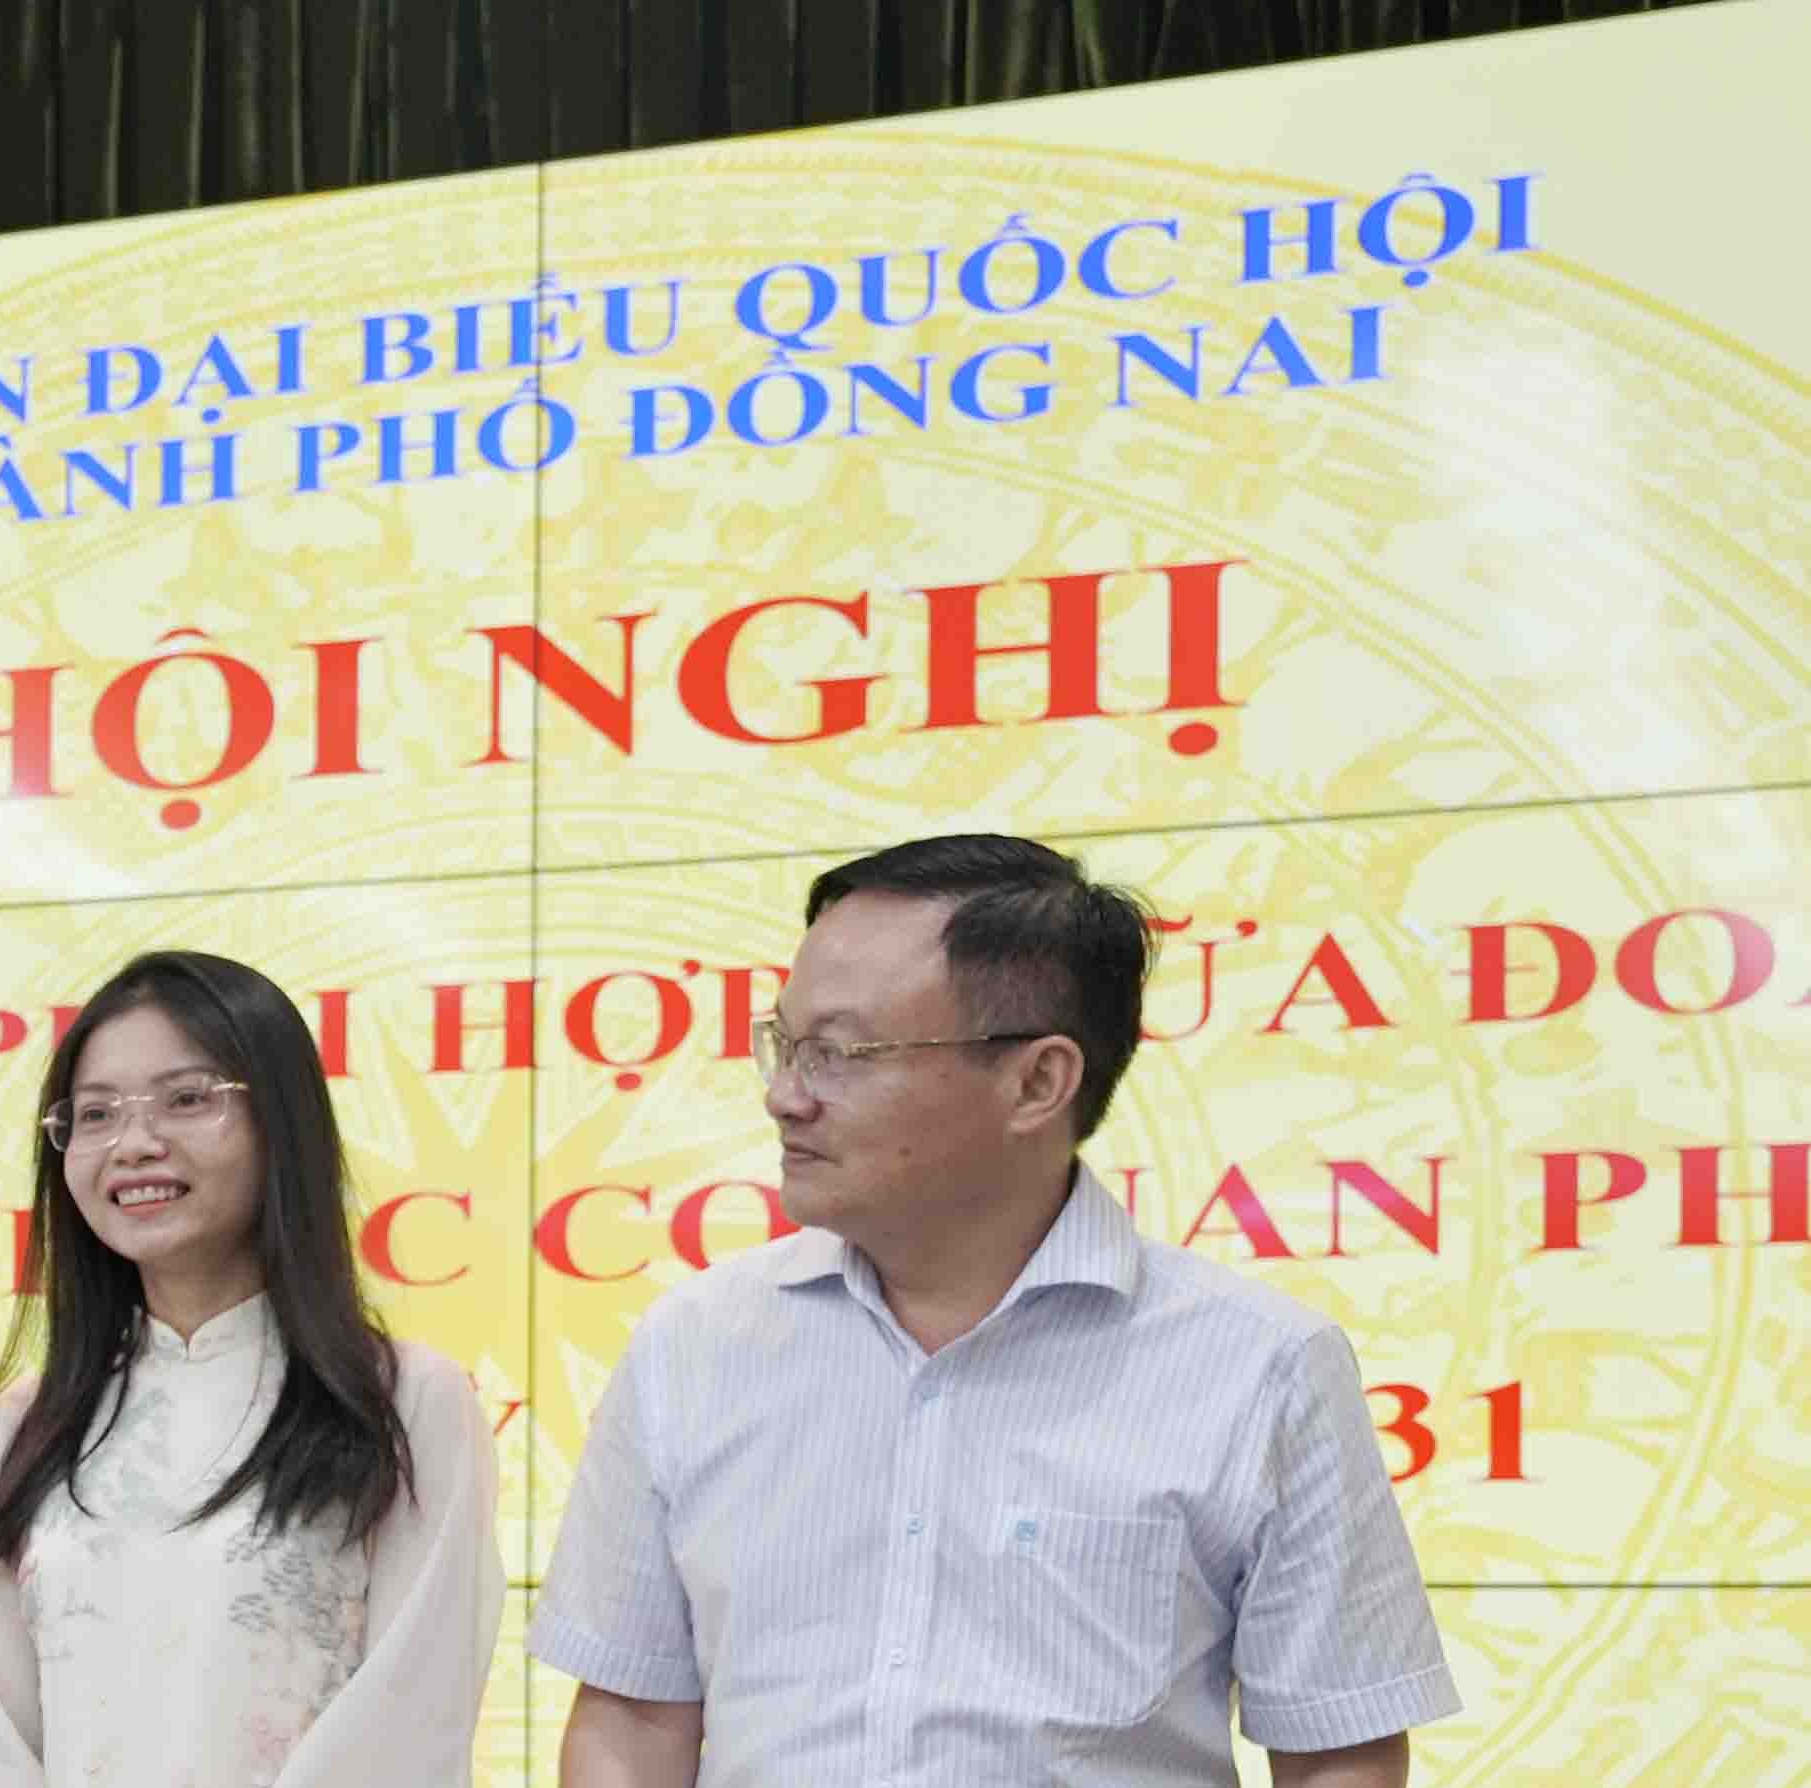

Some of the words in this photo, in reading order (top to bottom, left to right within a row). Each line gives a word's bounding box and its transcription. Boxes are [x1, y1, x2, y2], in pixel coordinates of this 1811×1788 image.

[77, 322, 311, 427] ĐẠI
[356, 270, 682, 386] BIỂU
[733, 211, 1181, 354] QUỐC
[1234, 171, 1544, 289] HỘI
[290, 375, 577, 496] PHỐ
[619, 342, 1057, 460] ĐỒNG
[1106, 304, 1395, 409] NAI
[465, 559, 1251, 768] NGHỊ
